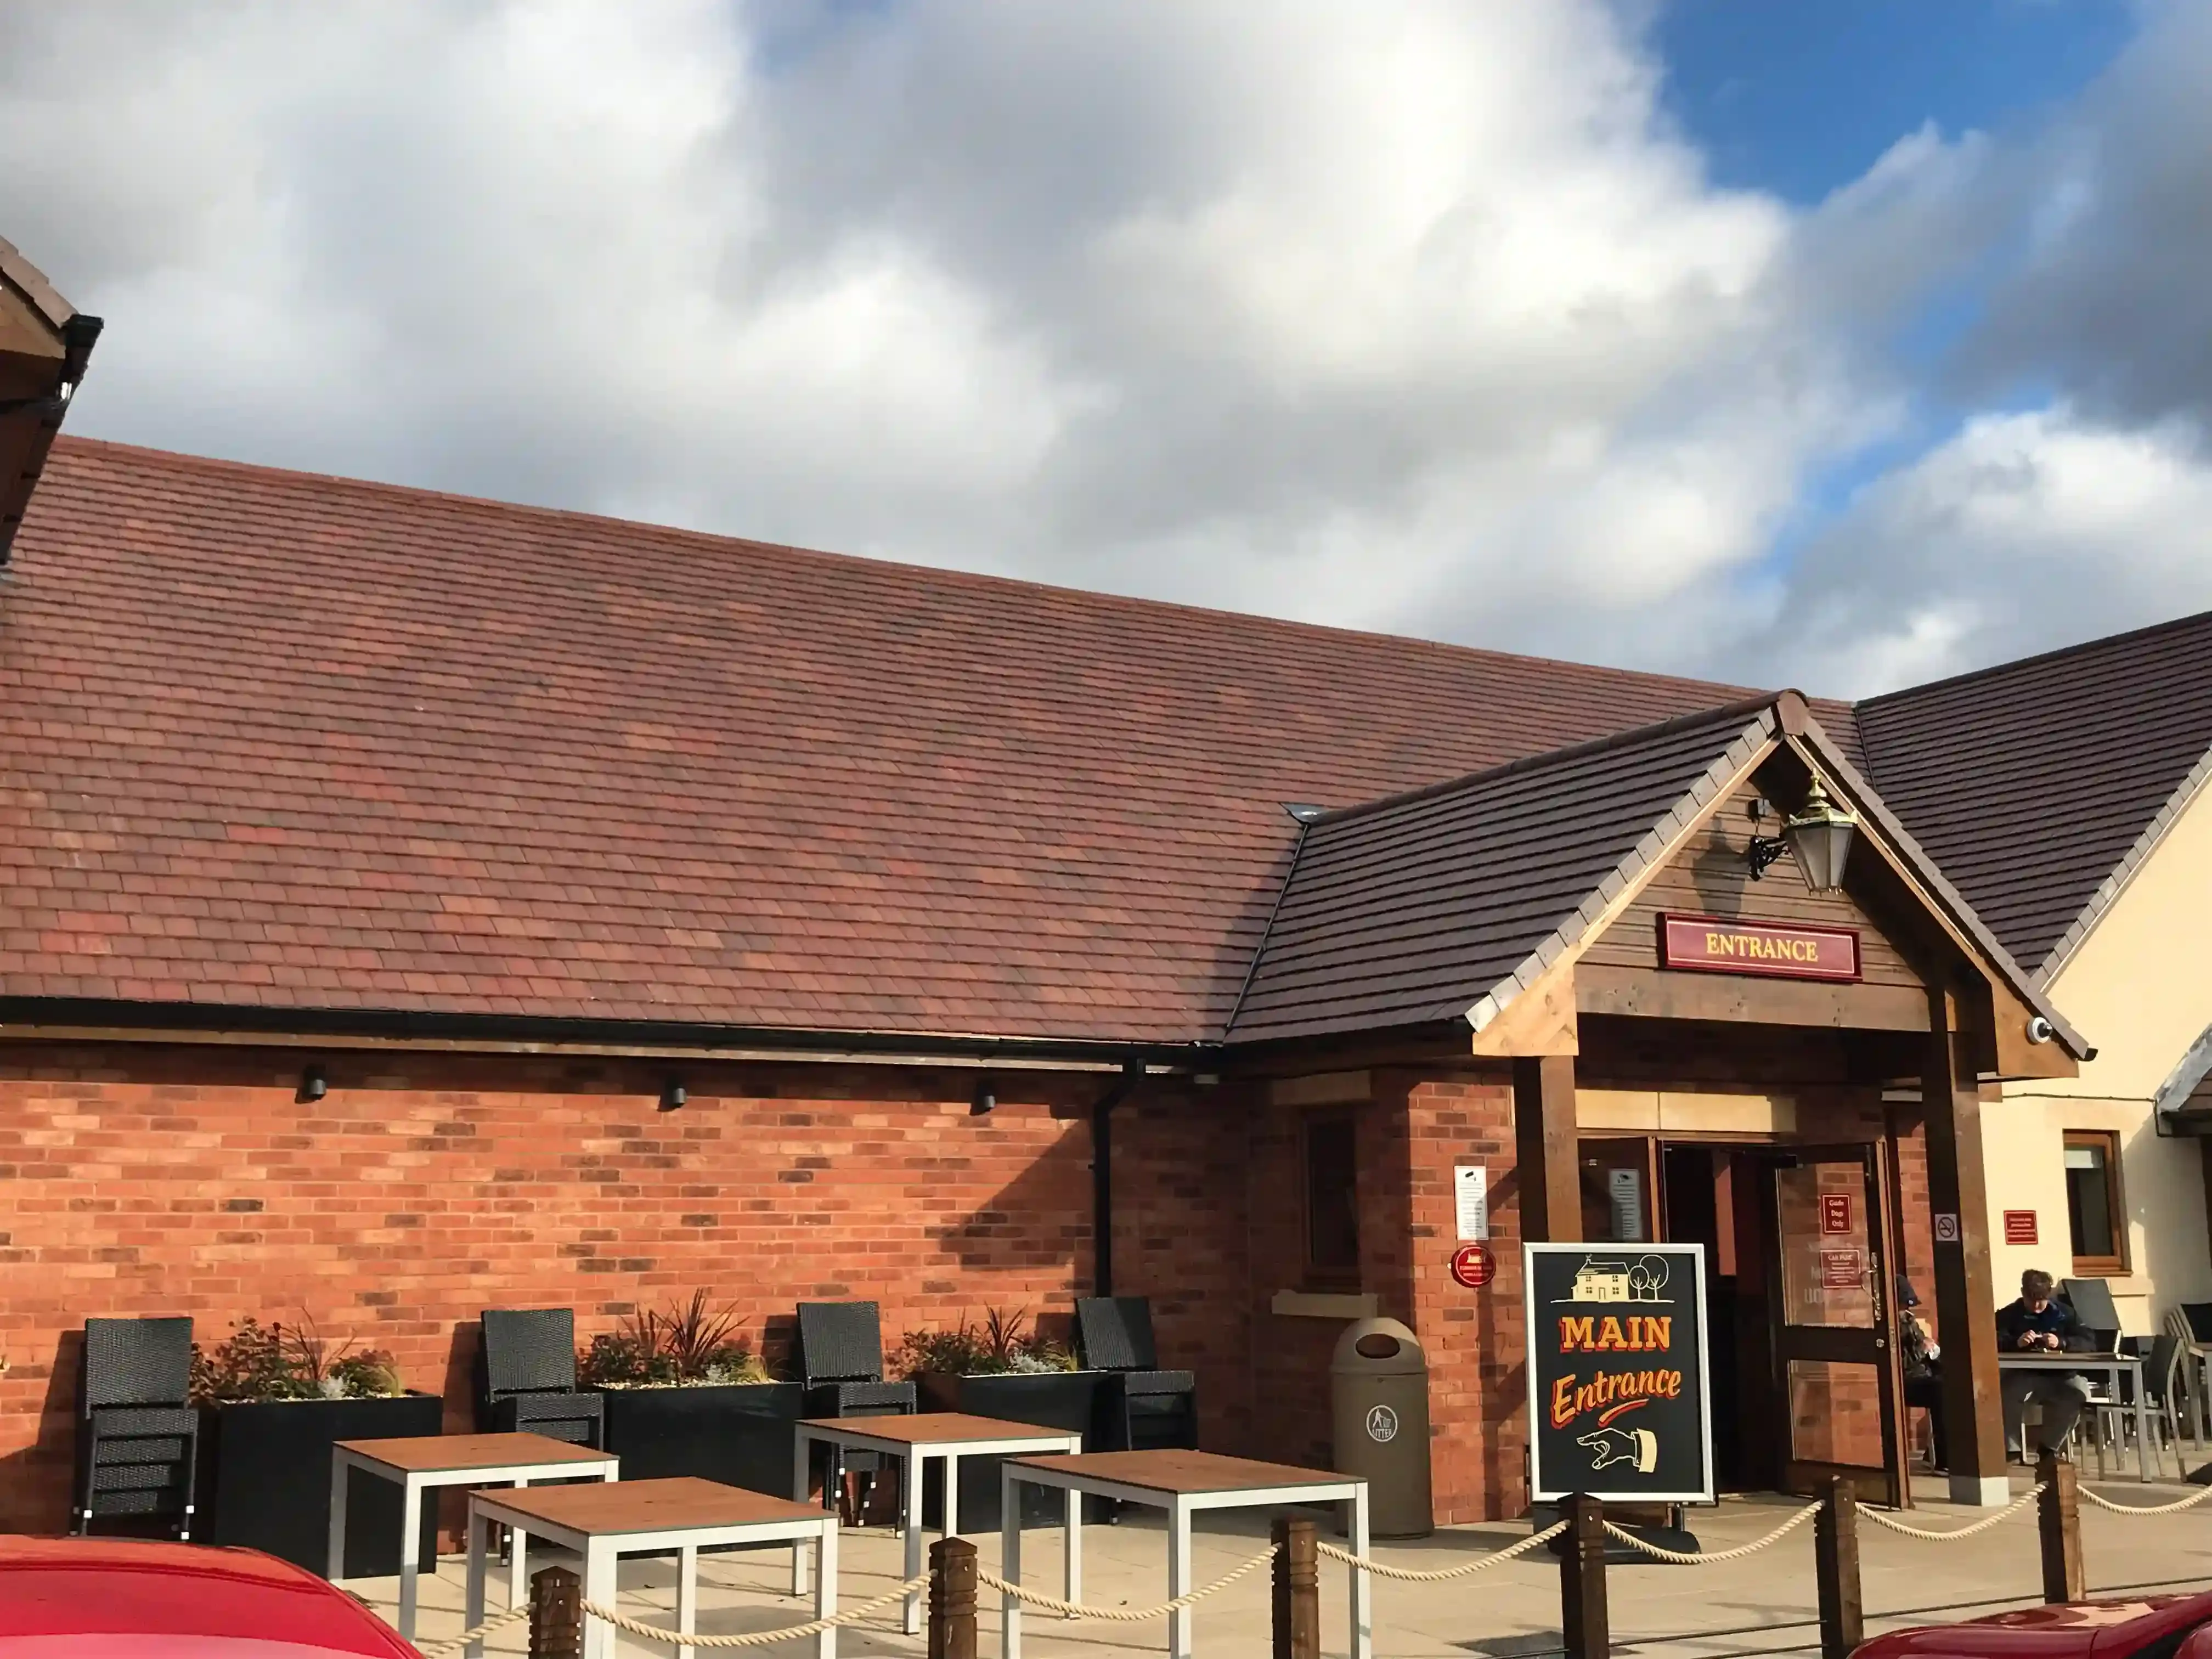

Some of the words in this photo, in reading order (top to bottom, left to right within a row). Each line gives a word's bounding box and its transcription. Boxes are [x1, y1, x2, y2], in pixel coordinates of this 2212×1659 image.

[1706, 933, 1818, 962] ENTRANCE
[1560, 1316, 1672, 1351] MAIN
[1552, 1369, 1681, 1426] Entrance
